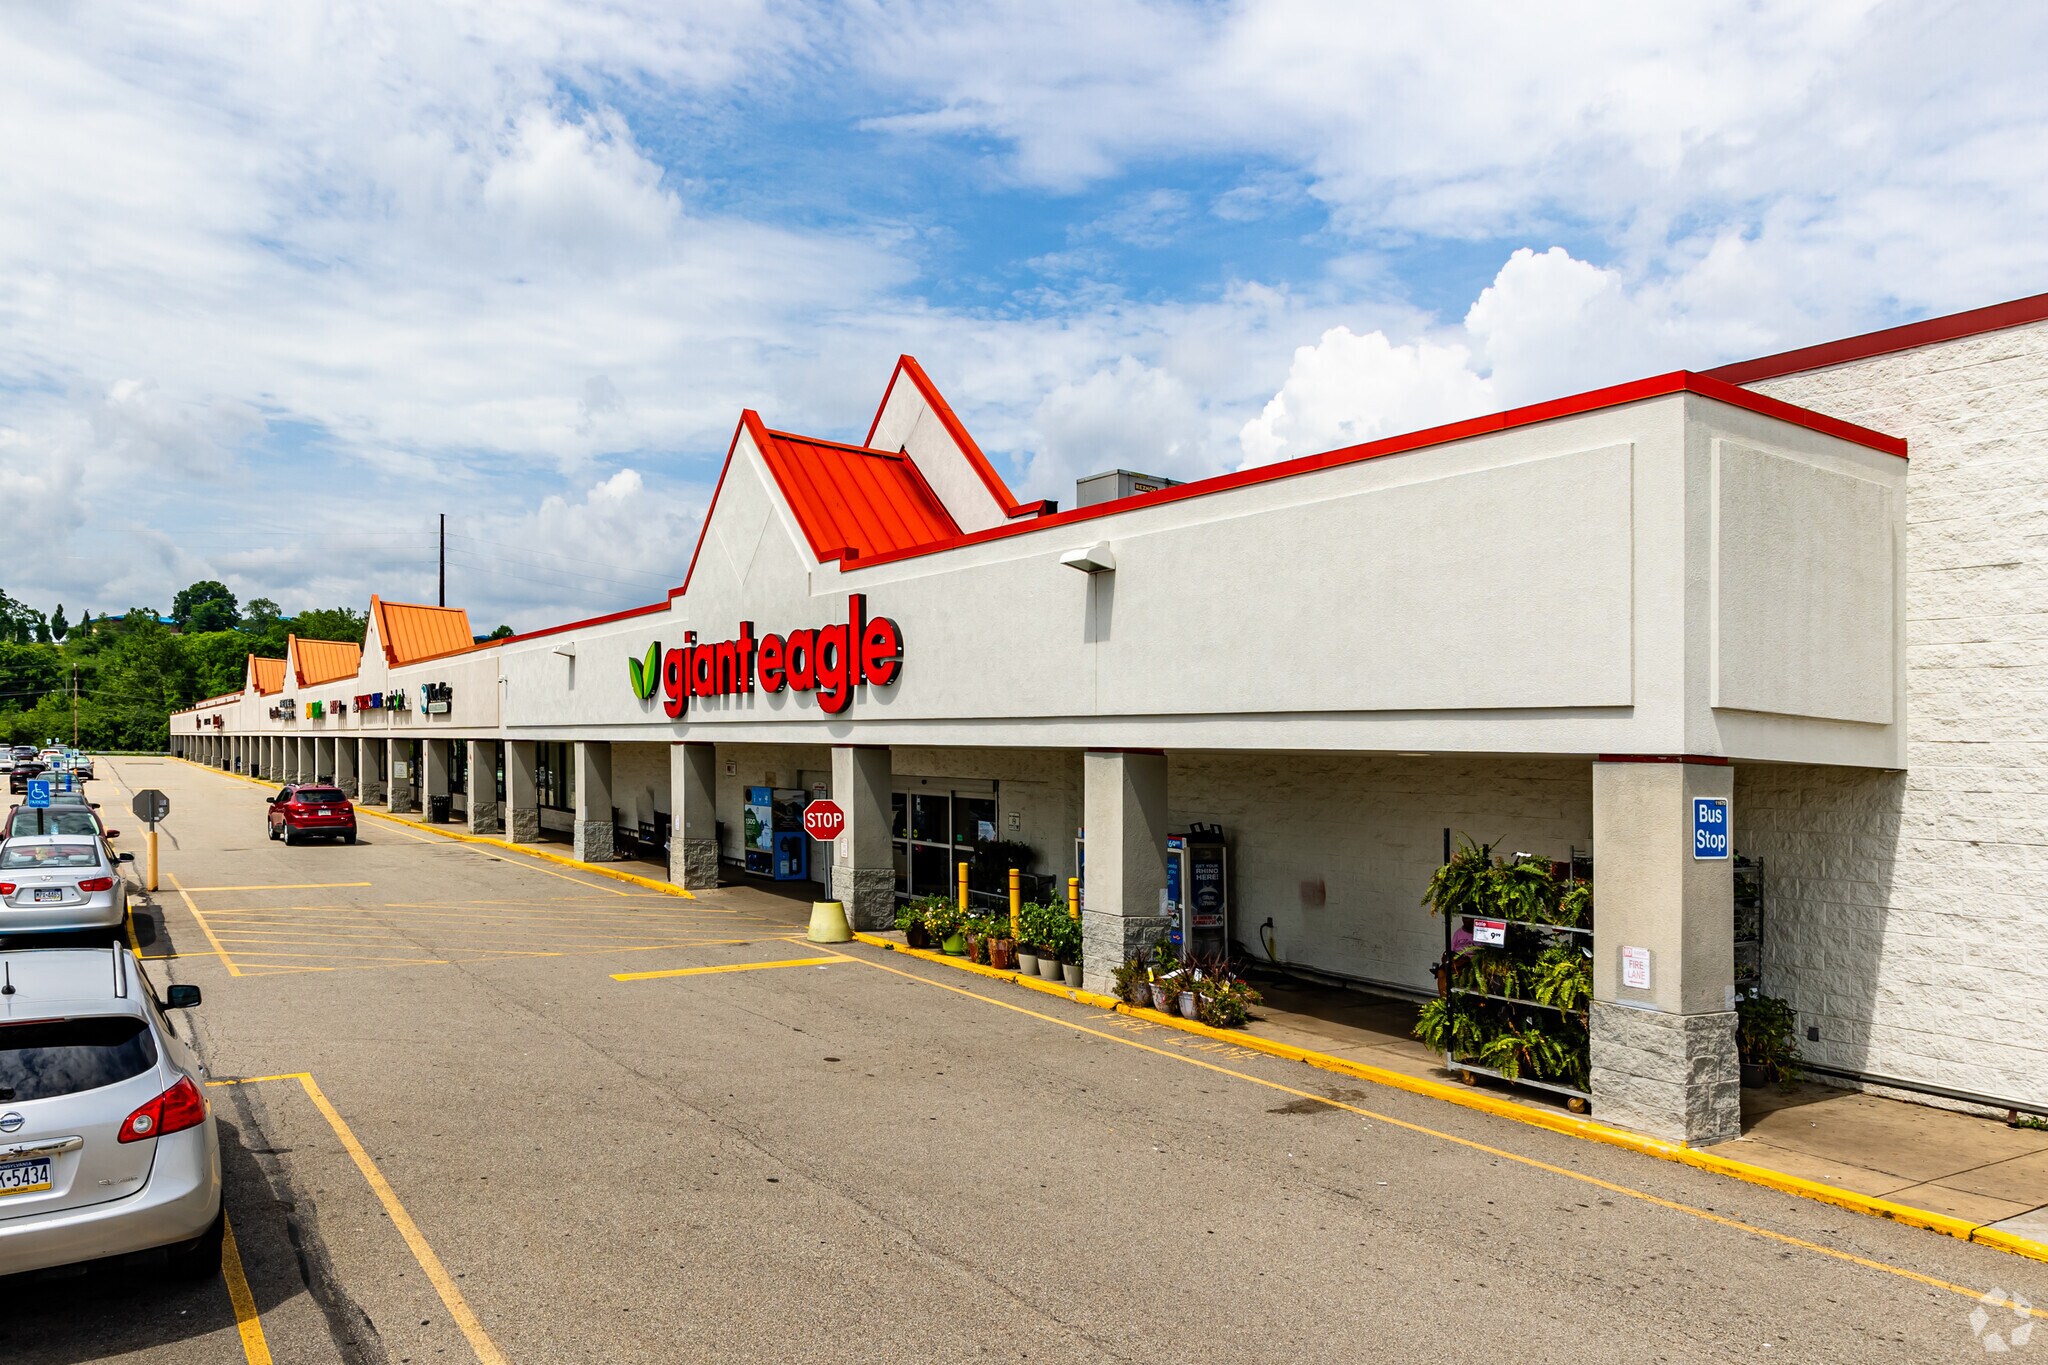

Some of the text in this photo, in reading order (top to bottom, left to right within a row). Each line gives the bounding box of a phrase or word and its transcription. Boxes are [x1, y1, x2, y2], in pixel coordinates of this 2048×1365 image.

[663, 593, 904, 719] giant eagle
[806, 812, 843, 828] STOP
[1699, 804, 1722, 823] Bus
[1696, 829, 1726, 852] Stop
[1629, 959, 1644, 970] FIRE
[1628, 969, 1646, 981] LANE
